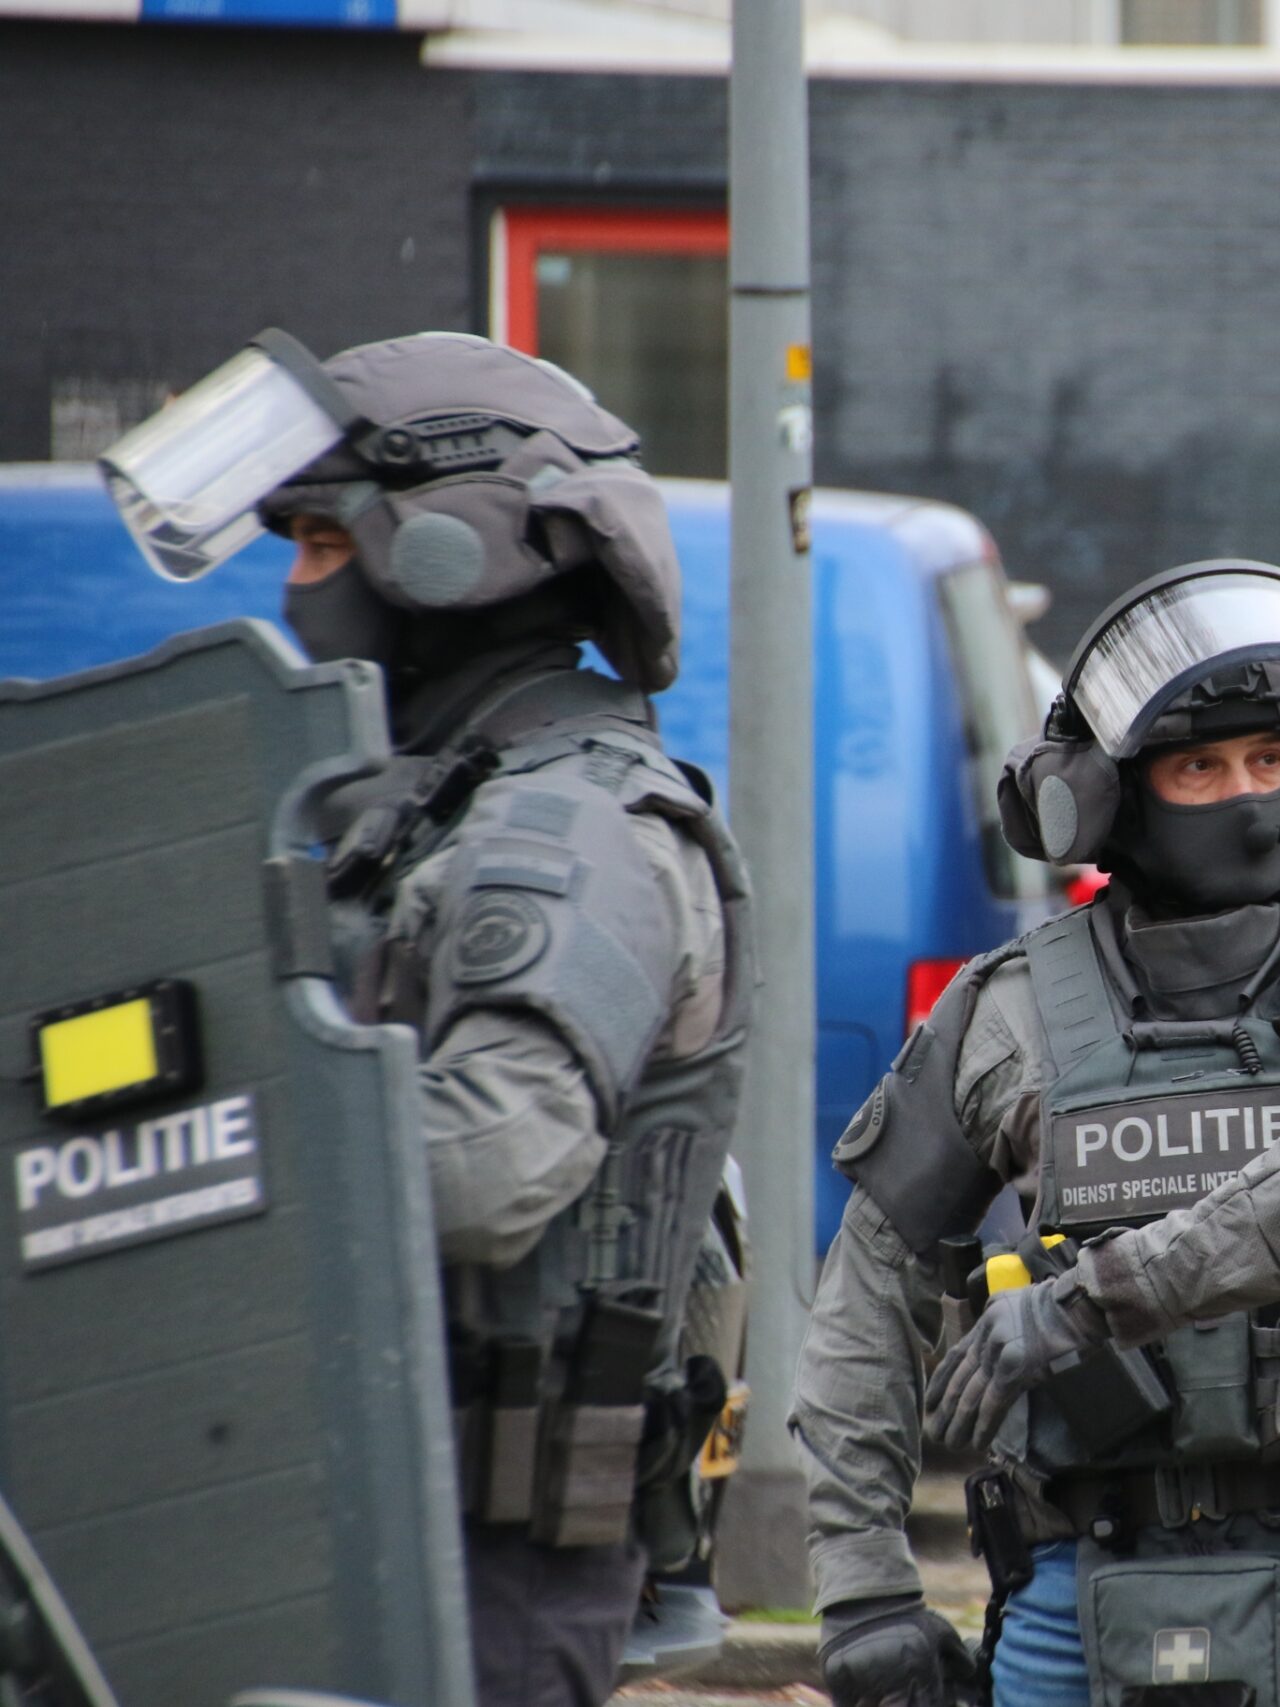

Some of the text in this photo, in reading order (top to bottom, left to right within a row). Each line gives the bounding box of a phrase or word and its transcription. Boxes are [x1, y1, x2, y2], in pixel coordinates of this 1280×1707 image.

[16, 1095, 256, 1211] POLITIE
[1063, 1183, 1117, 1207] DIENST
[1122, 1174, 1198, 1200] SPECIALE
